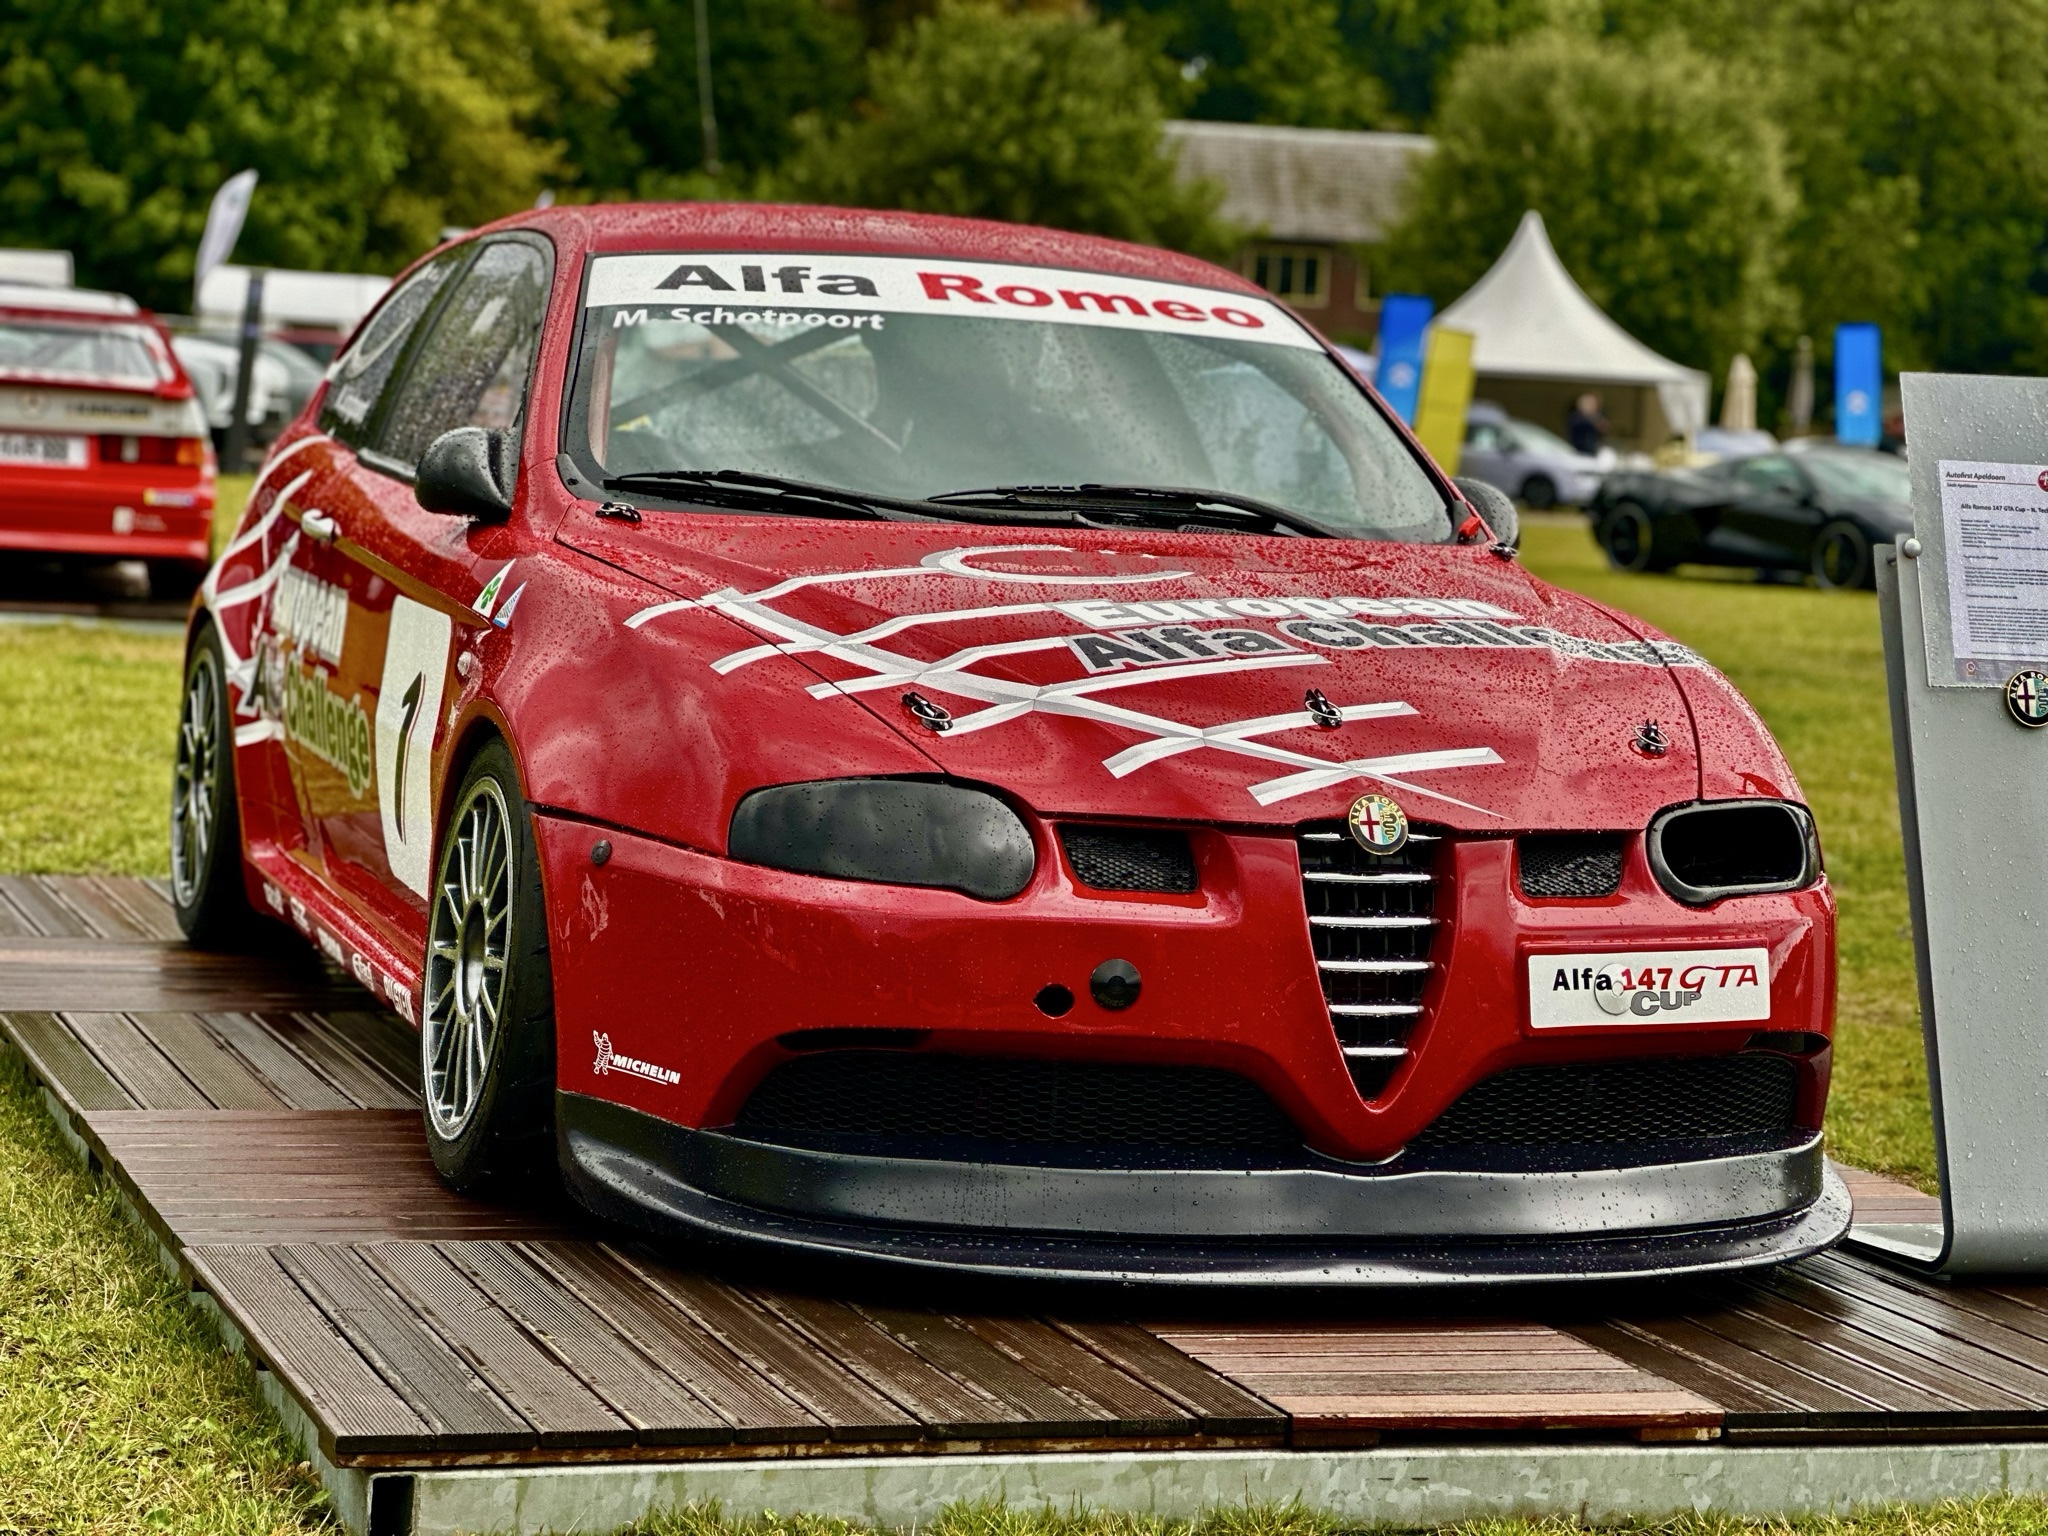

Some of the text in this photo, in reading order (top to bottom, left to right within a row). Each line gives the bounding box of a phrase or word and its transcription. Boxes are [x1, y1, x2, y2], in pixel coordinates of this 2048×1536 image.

[653, 264, 1265, 329] Alfa Romeo
[613, 307, 885, 331] M. Schotpoort
[1945, 471, 2006, 481] Autofirst Apeldoorn
[1050, 598, 1520, 628] European
[1072, 626, 1288, 669] Alfa
[2009, 674, 2027, 699] ALFA
[285, 655, 373, 797] Challenge
[393, 670, 427, 846] 1
[1351, 796, 1407, 826] ALFA ROMEO
[1552, 964, 1759, 993] Alfa 147 GTA
[1630, 990, 1702, 1017] CUP
[612, 1054, 681, 1085] MICHELIN
